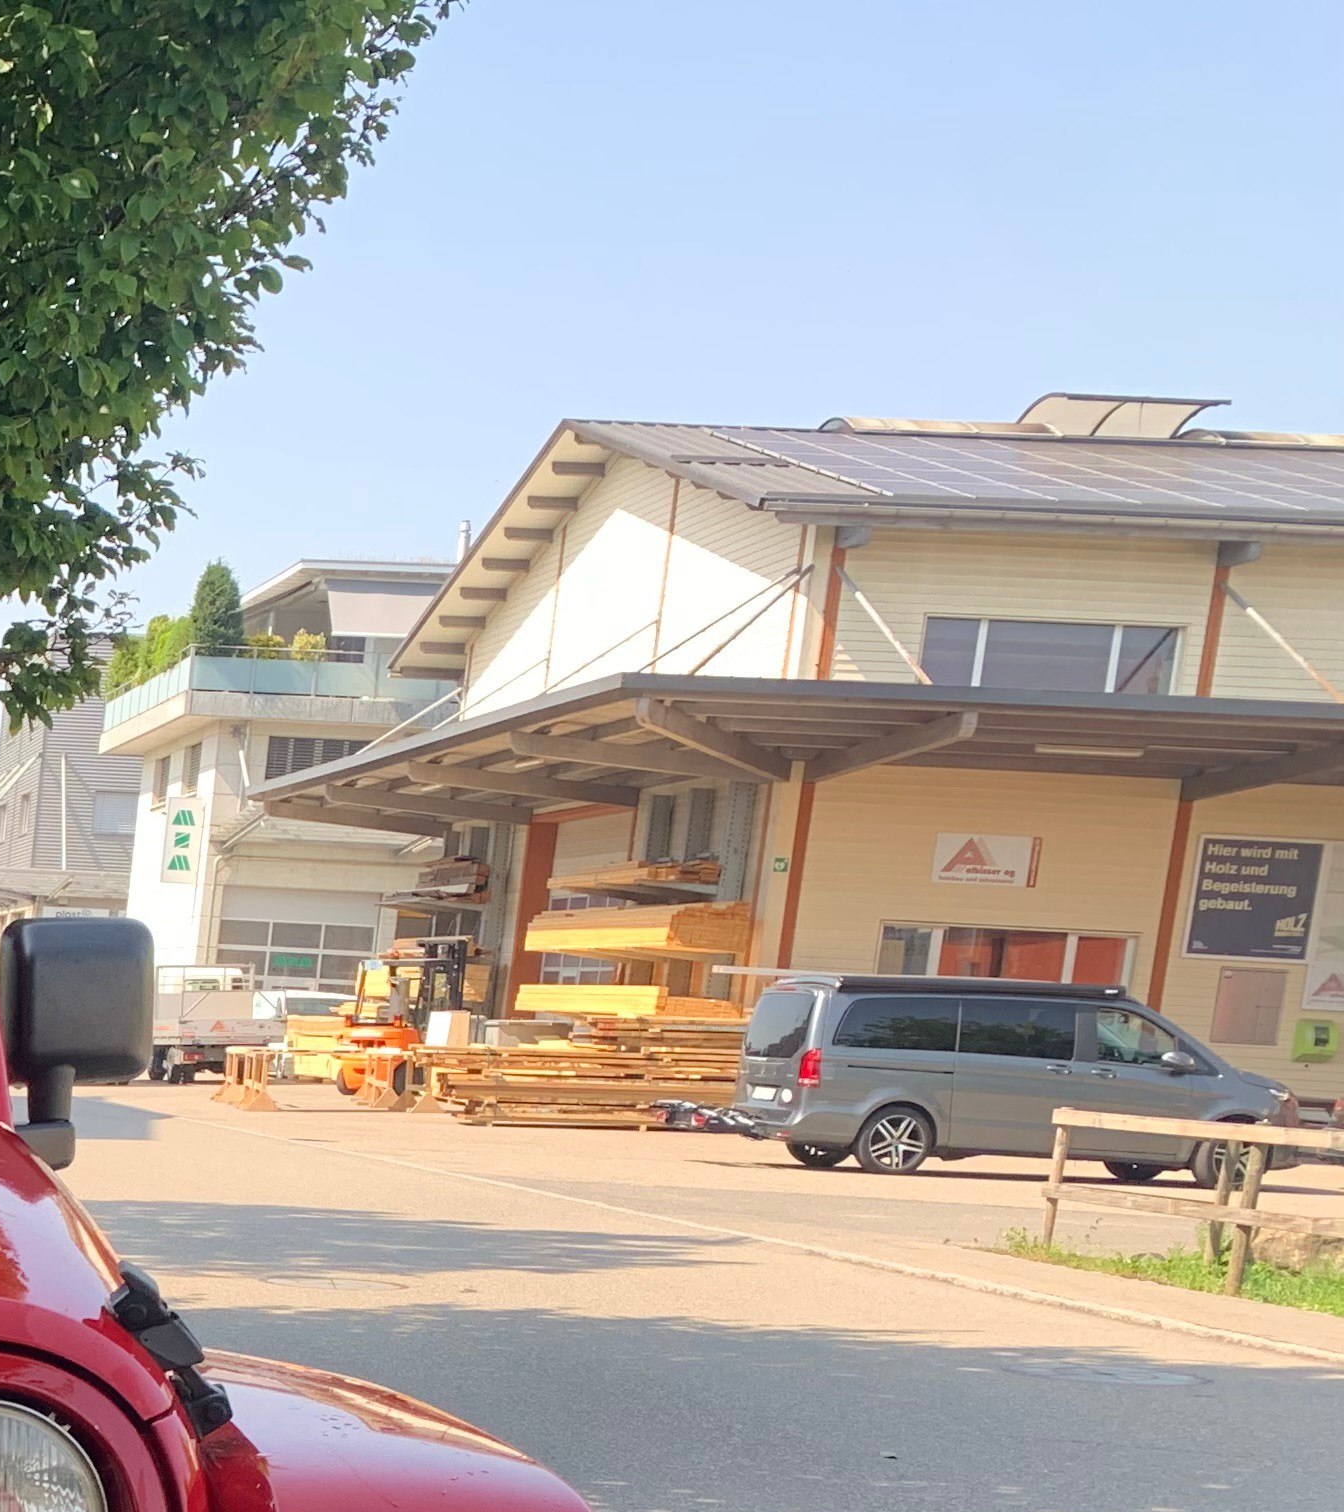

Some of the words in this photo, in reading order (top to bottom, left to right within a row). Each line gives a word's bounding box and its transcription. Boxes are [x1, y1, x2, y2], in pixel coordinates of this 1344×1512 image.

[1207, 843, 1238, 857] Hier
[1241, 846, 1272, 859] wird
[1275, 848, 1299, 860] mit
[1204, 861, 1238, 875] Holz
[1240, 864, 1269, 876] und
[1201, 878, 1297, 897] Begeisterung
[1198, 897, 1253, 911] gebaut.
